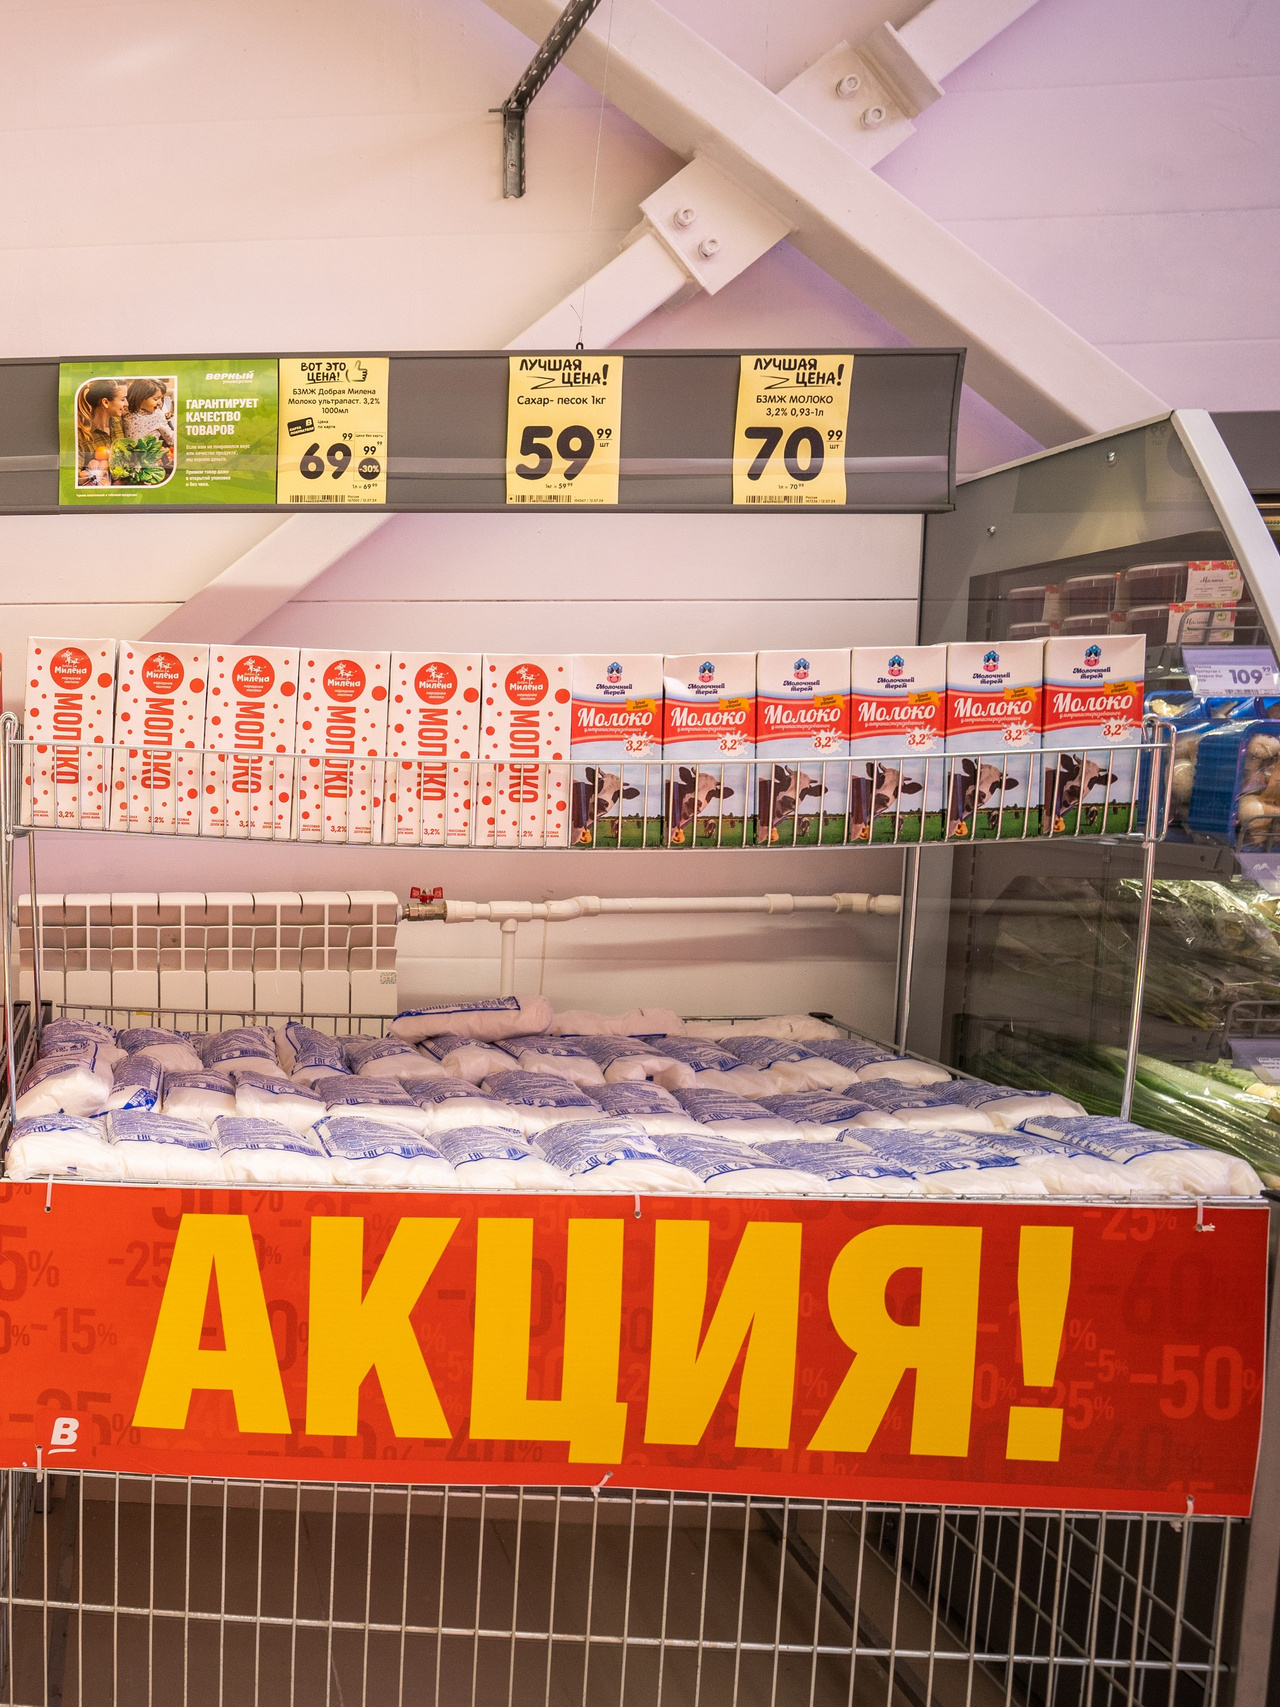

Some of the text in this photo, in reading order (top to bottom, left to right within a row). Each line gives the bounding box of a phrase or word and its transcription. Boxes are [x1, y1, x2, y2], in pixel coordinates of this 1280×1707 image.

[301, 362, 346, 371] ВОТ ЭТО
[520, 359, 582, 371] ЛУЧШАЯ
[754, 358, 817, 370] ЛУЧШАЯ
[562, 364, 609, 386] ЦЕНА!
[796, 364, 844, 387] ЦЕНА!
[318, 388, 345, 396] Добрая
[186, 398, 258, 409] ГАРАНТИРУЕТ
[517, 396, 554, 406] Сахар-
[592, 396, 606, 404] 1кг
[756, 395, 786, 403] БЗМЖ
[186, 411, 240, 422] КАЧЕСТВО
[766, 408, 823, 416] 3,2% 0,93-1л
[186, 425, 234, 435] ТОВАРОВ
[364, 446, 376, 455] 99
[516, 425, 612, 480] 59 99
[745, 426, 843, 481] 70 99
[300, 443, 352, 479] 69
[1229, 669, 1262, 684] 109
[954, 698, 1032, 718] Молоко
[1053, 692, 1132, 712] Молоко
[578, 708, 653, 726] Молоко
[671, 707, 746, 726] Молоко
[765, 704, 840, 724] Молоко
[858, 702, 936, 722] Молоко
[1004, 728, 1028, 741] 3,2%
[1103, 723, 1128, 736] 3,2%
[625, 739, 648, 752] 3,2%
[720, 738, 743, 751] 3,2%
[814, 735, 837, 749] 3,2%
[908, 733, 931, 746] 3,2%
[132, 1213, 1074, 1465] АКЦИЯ!
